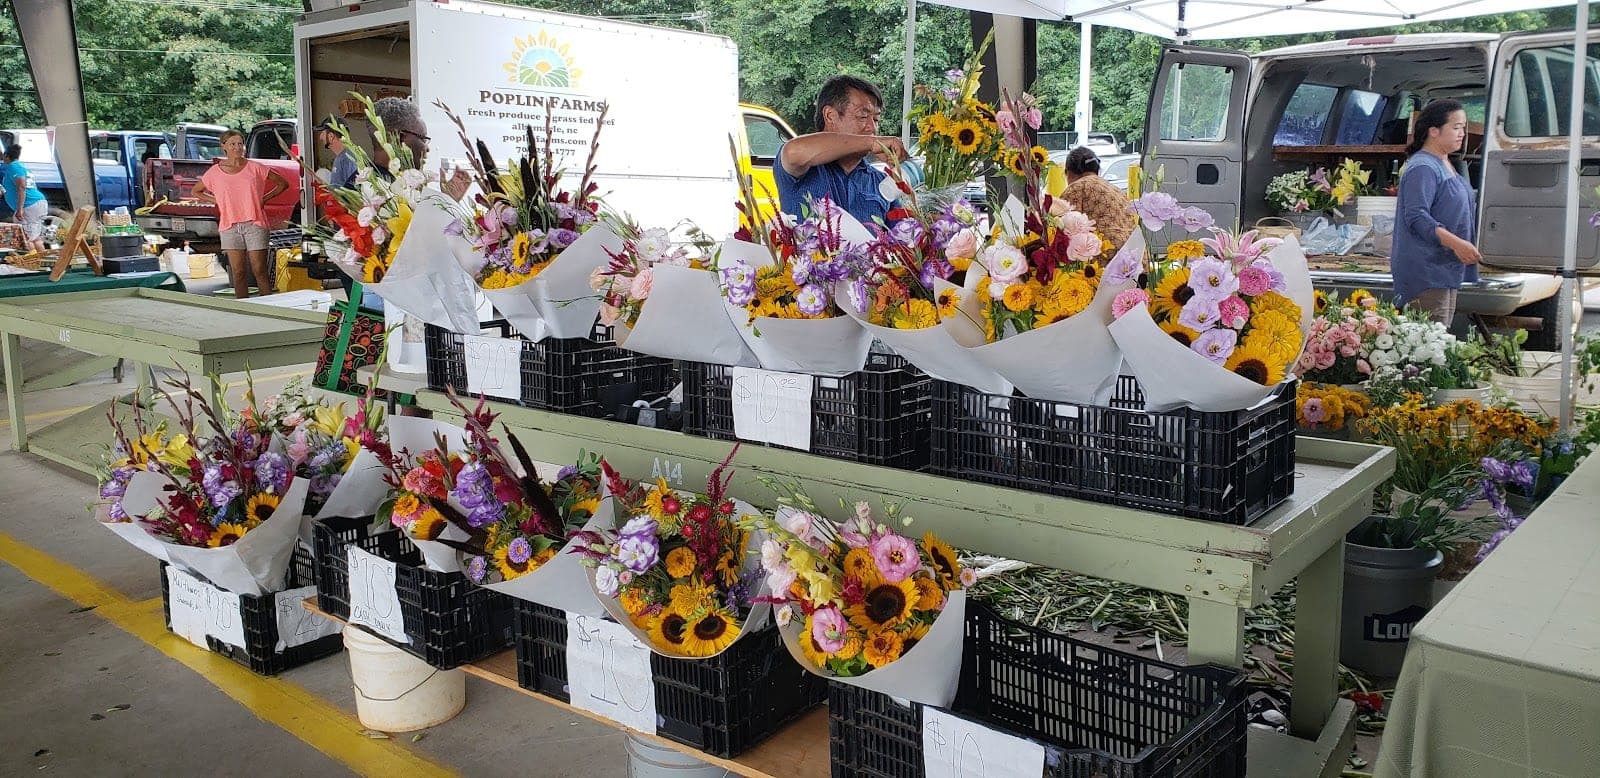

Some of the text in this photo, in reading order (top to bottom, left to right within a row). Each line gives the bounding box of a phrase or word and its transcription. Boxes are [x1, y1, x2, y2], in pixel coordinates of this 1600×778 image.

[480, 91, 605, 112] POPLIN FARMS
[468, 108, 495, 117] fresh
[499, 111, 541, 121] produce
[552, 116, 577, 124] grass
[579, 117, 593, 125] fed
[512, 124, 565, 134] albmale,
[651, 457, 683, 485] A14
